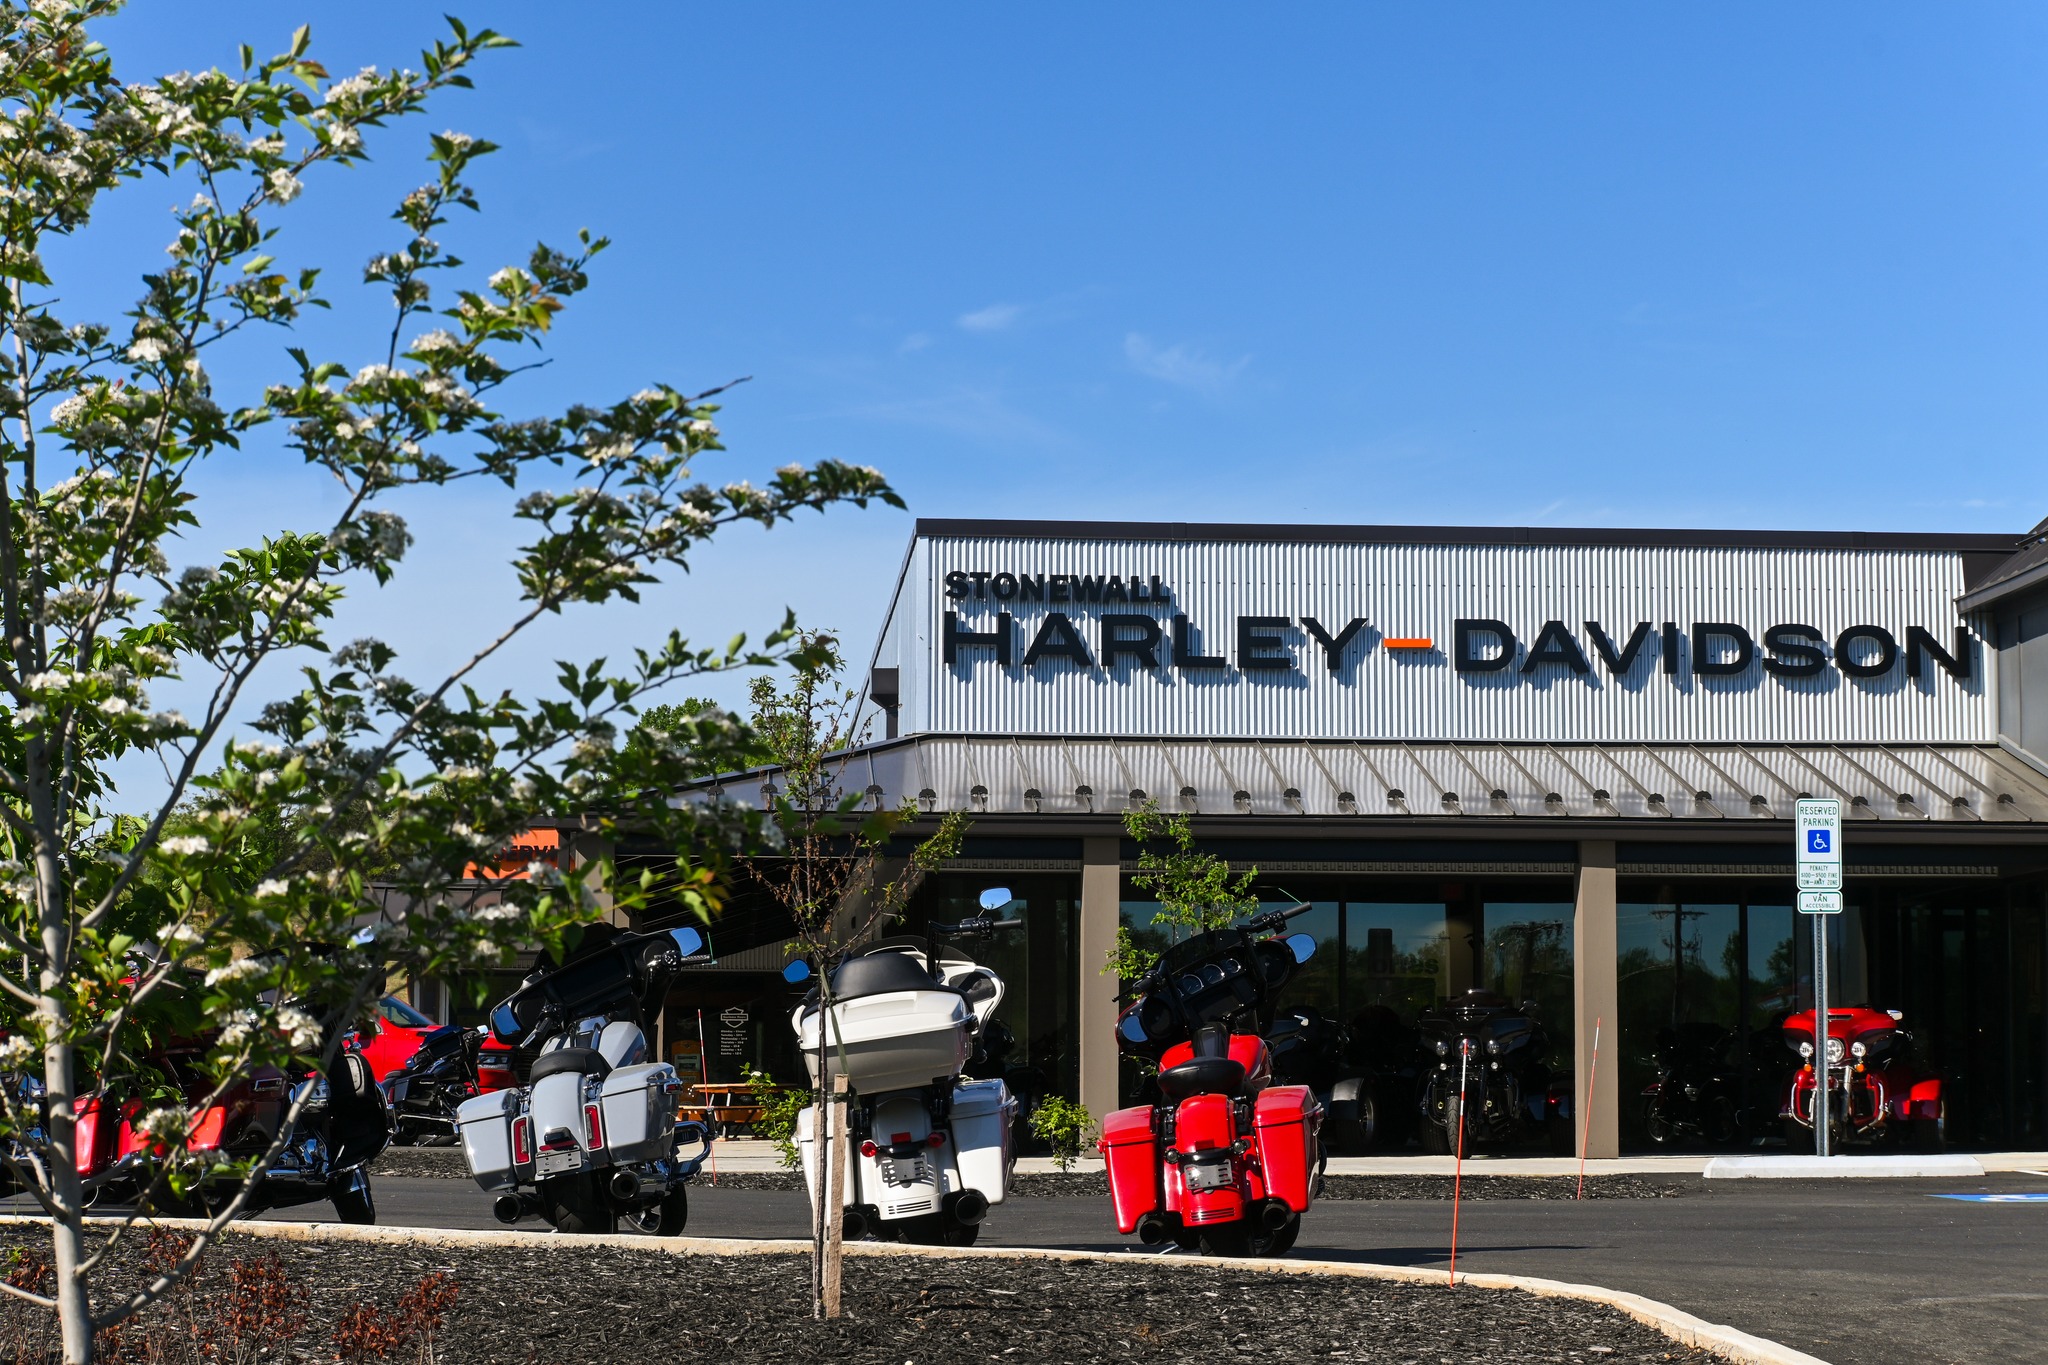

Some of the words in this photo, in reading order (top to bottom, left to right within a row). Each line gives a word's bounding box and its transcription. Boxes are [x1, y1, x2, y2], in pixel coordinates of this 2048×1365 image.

[945, 570, 1171, 603] STONEWALL
[1800, 806, 1837, 815] RESERVED
[1803, 817, 1834, 827] PARKING
